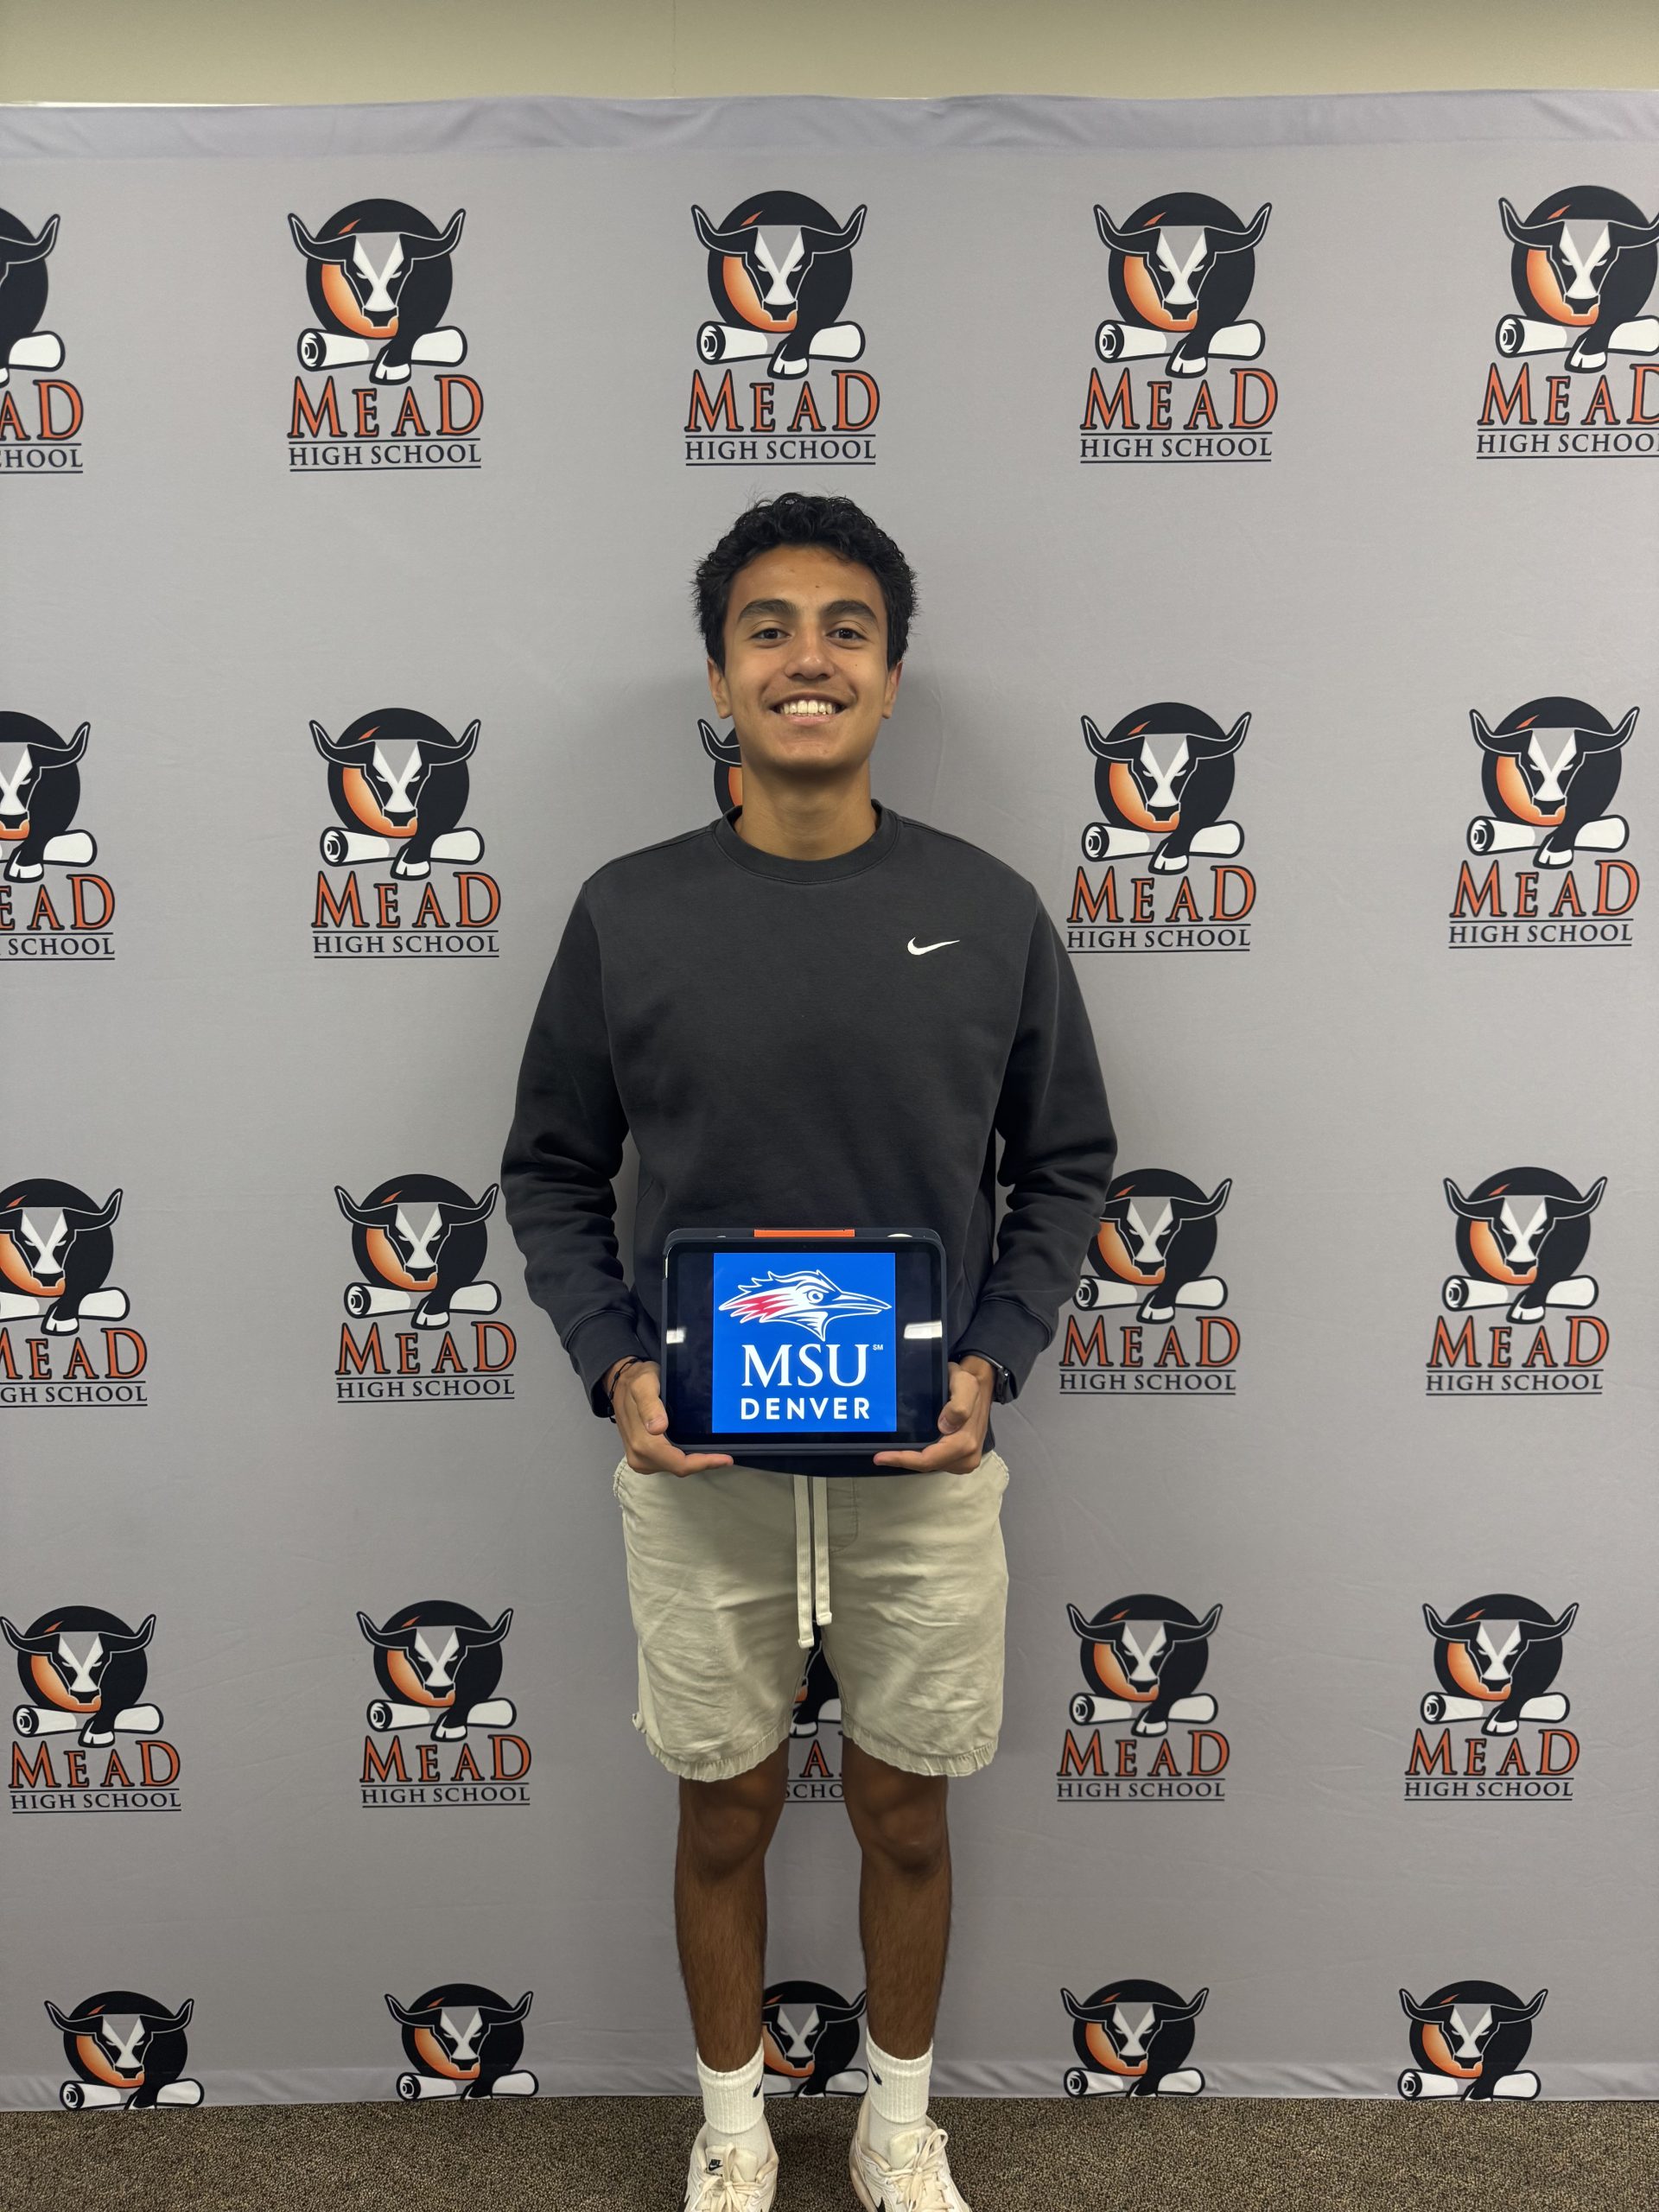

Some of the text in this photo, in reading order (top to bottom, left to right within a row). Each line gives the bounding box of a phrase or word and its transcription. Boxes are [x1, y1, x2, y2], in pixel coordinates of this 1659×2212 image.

[0, 379, 84, 442] AD
[287, 374, 484, 439] MEAD
[684, 369, 880, 432] MEAD
[1080, 368, 1278, 430] MEAD
[1477, 362, 1659, 426] MEAD
[0, 449, 82, 467] HOOL
[289, 444, 481, 466] HIGH SCHOOL
[685, 441, 875, 460] HIGH SCHOOL
[1081, 438, 1272, 457] HIGH SCHOOL
[1477, 434, 1659, 453] HIGH SCHOO
[0, 874, 115, 931] EAD
[311, 871, 501, 928] MEAD
[1066, 865, 1256, 923] MEAD
[1449, 860, 1640, 918] MEAD
[9, 938, 114, 955] SCHOOL
[313, 936, 499, 953] HIGH SCHOOL
[1067, 930, 1250, 948] HIGH SCHOOL
[1449, 925, 1632, 943] HIGH SCHOOL
[0, 1327, 147, 1380] EAD
[334, 1321, 517, 1376] MEAD
[1058, 1314, 1240, 1368] MEAD
[1426, 1315, 1609, 1368] MEAD
[741, 1344, 870, 1388] MSU
[1059, 1374, 1236, 1389] HIGH SCHOOL
[1427, 1375, 1602, 1390] HIGH SCHOOL
[0, 1386, 147, 1402] GH SCHOOL
[336, 1379, 514, 1398] HIGH SCHOOL
[741, 1397, 870, 1420] DENVER
[8, 1740, 181, 1789] MEAD
[359, 1734, 531, 1783] MEAD
[1056, 1729, 1230, 1777] MEAD
[1404, 1728, 1580, 1776] MEAD
[10, 1793, 181, 1808] HIGH SCHOOL
[361, 1787, 530, 1803] HIGH SCHOOL
[1058, 1783, 1224, 1797] HIGH SCHOOL
[1405, 1783, 1573, 1796] HIGH SCHOOL
